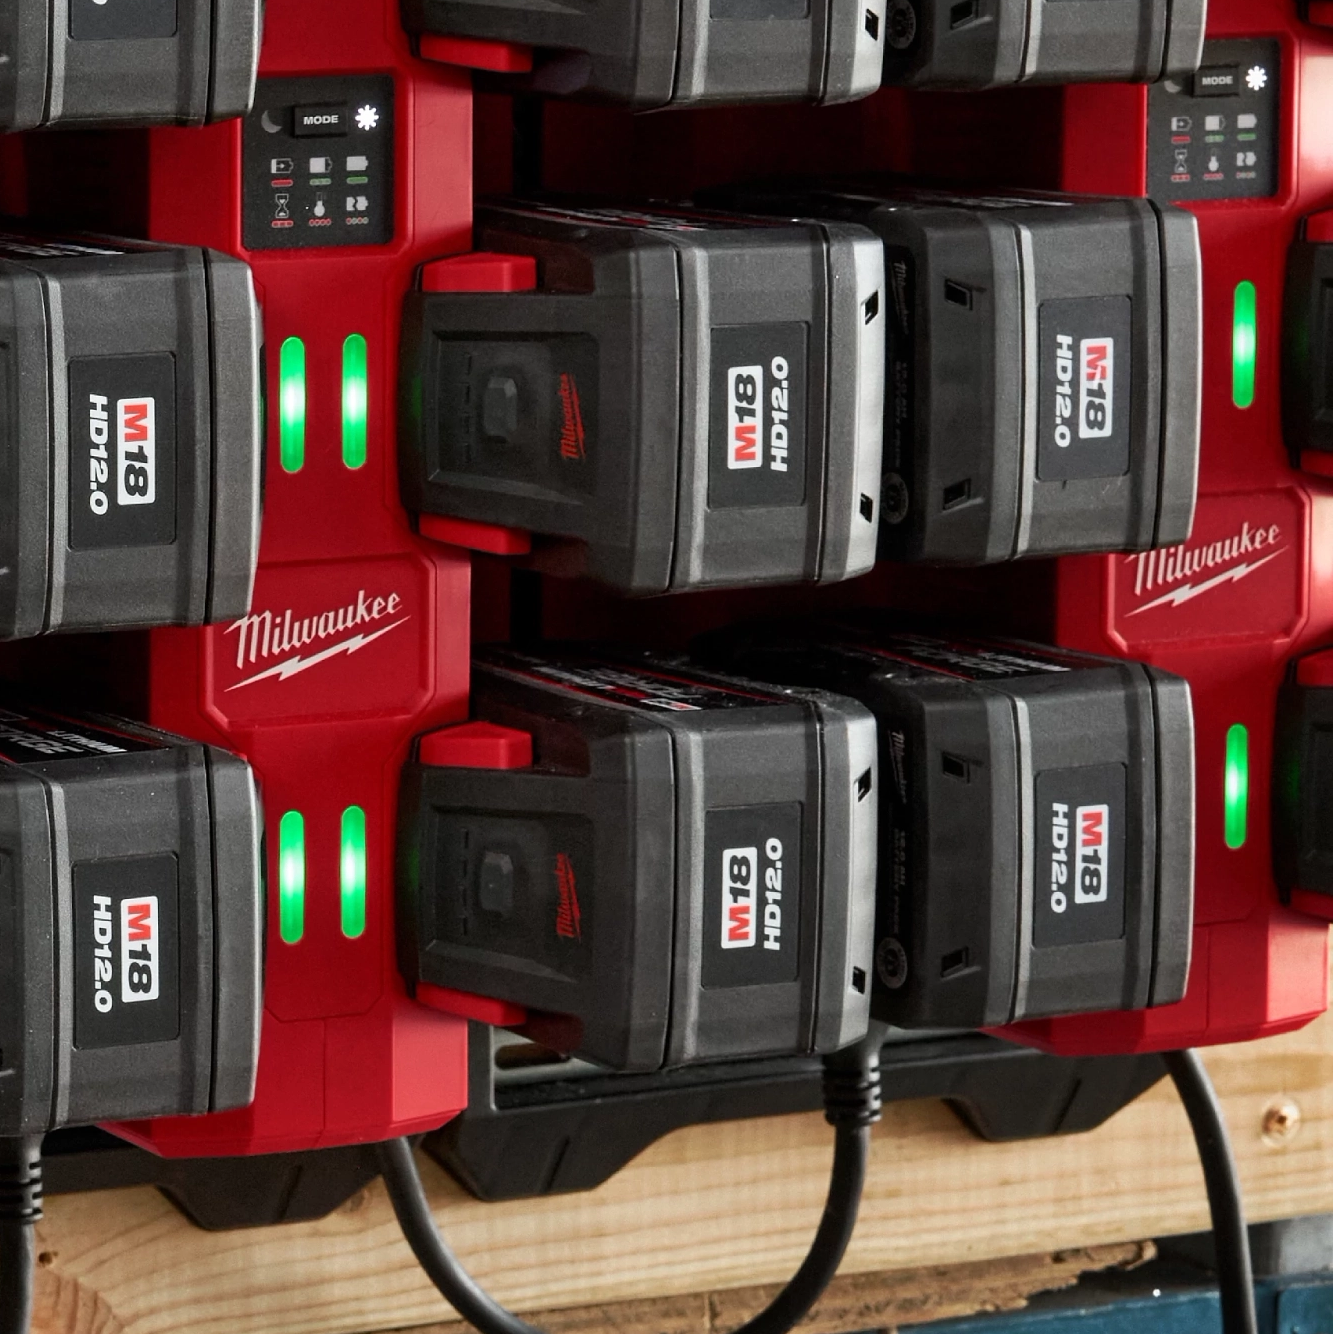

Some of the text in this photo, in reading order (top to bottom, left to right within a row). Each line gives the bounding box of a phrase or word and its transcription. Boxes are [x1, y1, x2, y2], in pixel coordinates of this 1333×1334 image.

[303, 115, 339, 125] MODE
[1202, 76, 1233, 85] MODE
[734, 373, 757, 461] M18
[770, 356, 789, 472] HD12.0
[1054, 334, 1073, 447] HD12.0
[1085, 345, 1107, 431] M18
[88, 394, 109, 515] HD12.0
[123, 404, 149, 497] M18
[1124, 522, 1282, 596] Milwaukee
[223, 589, 403, 670] Milwaukee
[728, 855, 751, 941] M18
[763, 837, 783, 950] HD12.0
[1050, 802, 1069, 914] HD12.0
[1081, 811, 1103, 896] M18
[93, 895, 113, 1013] HD12.0
[127, 904, 152, 994] M18
